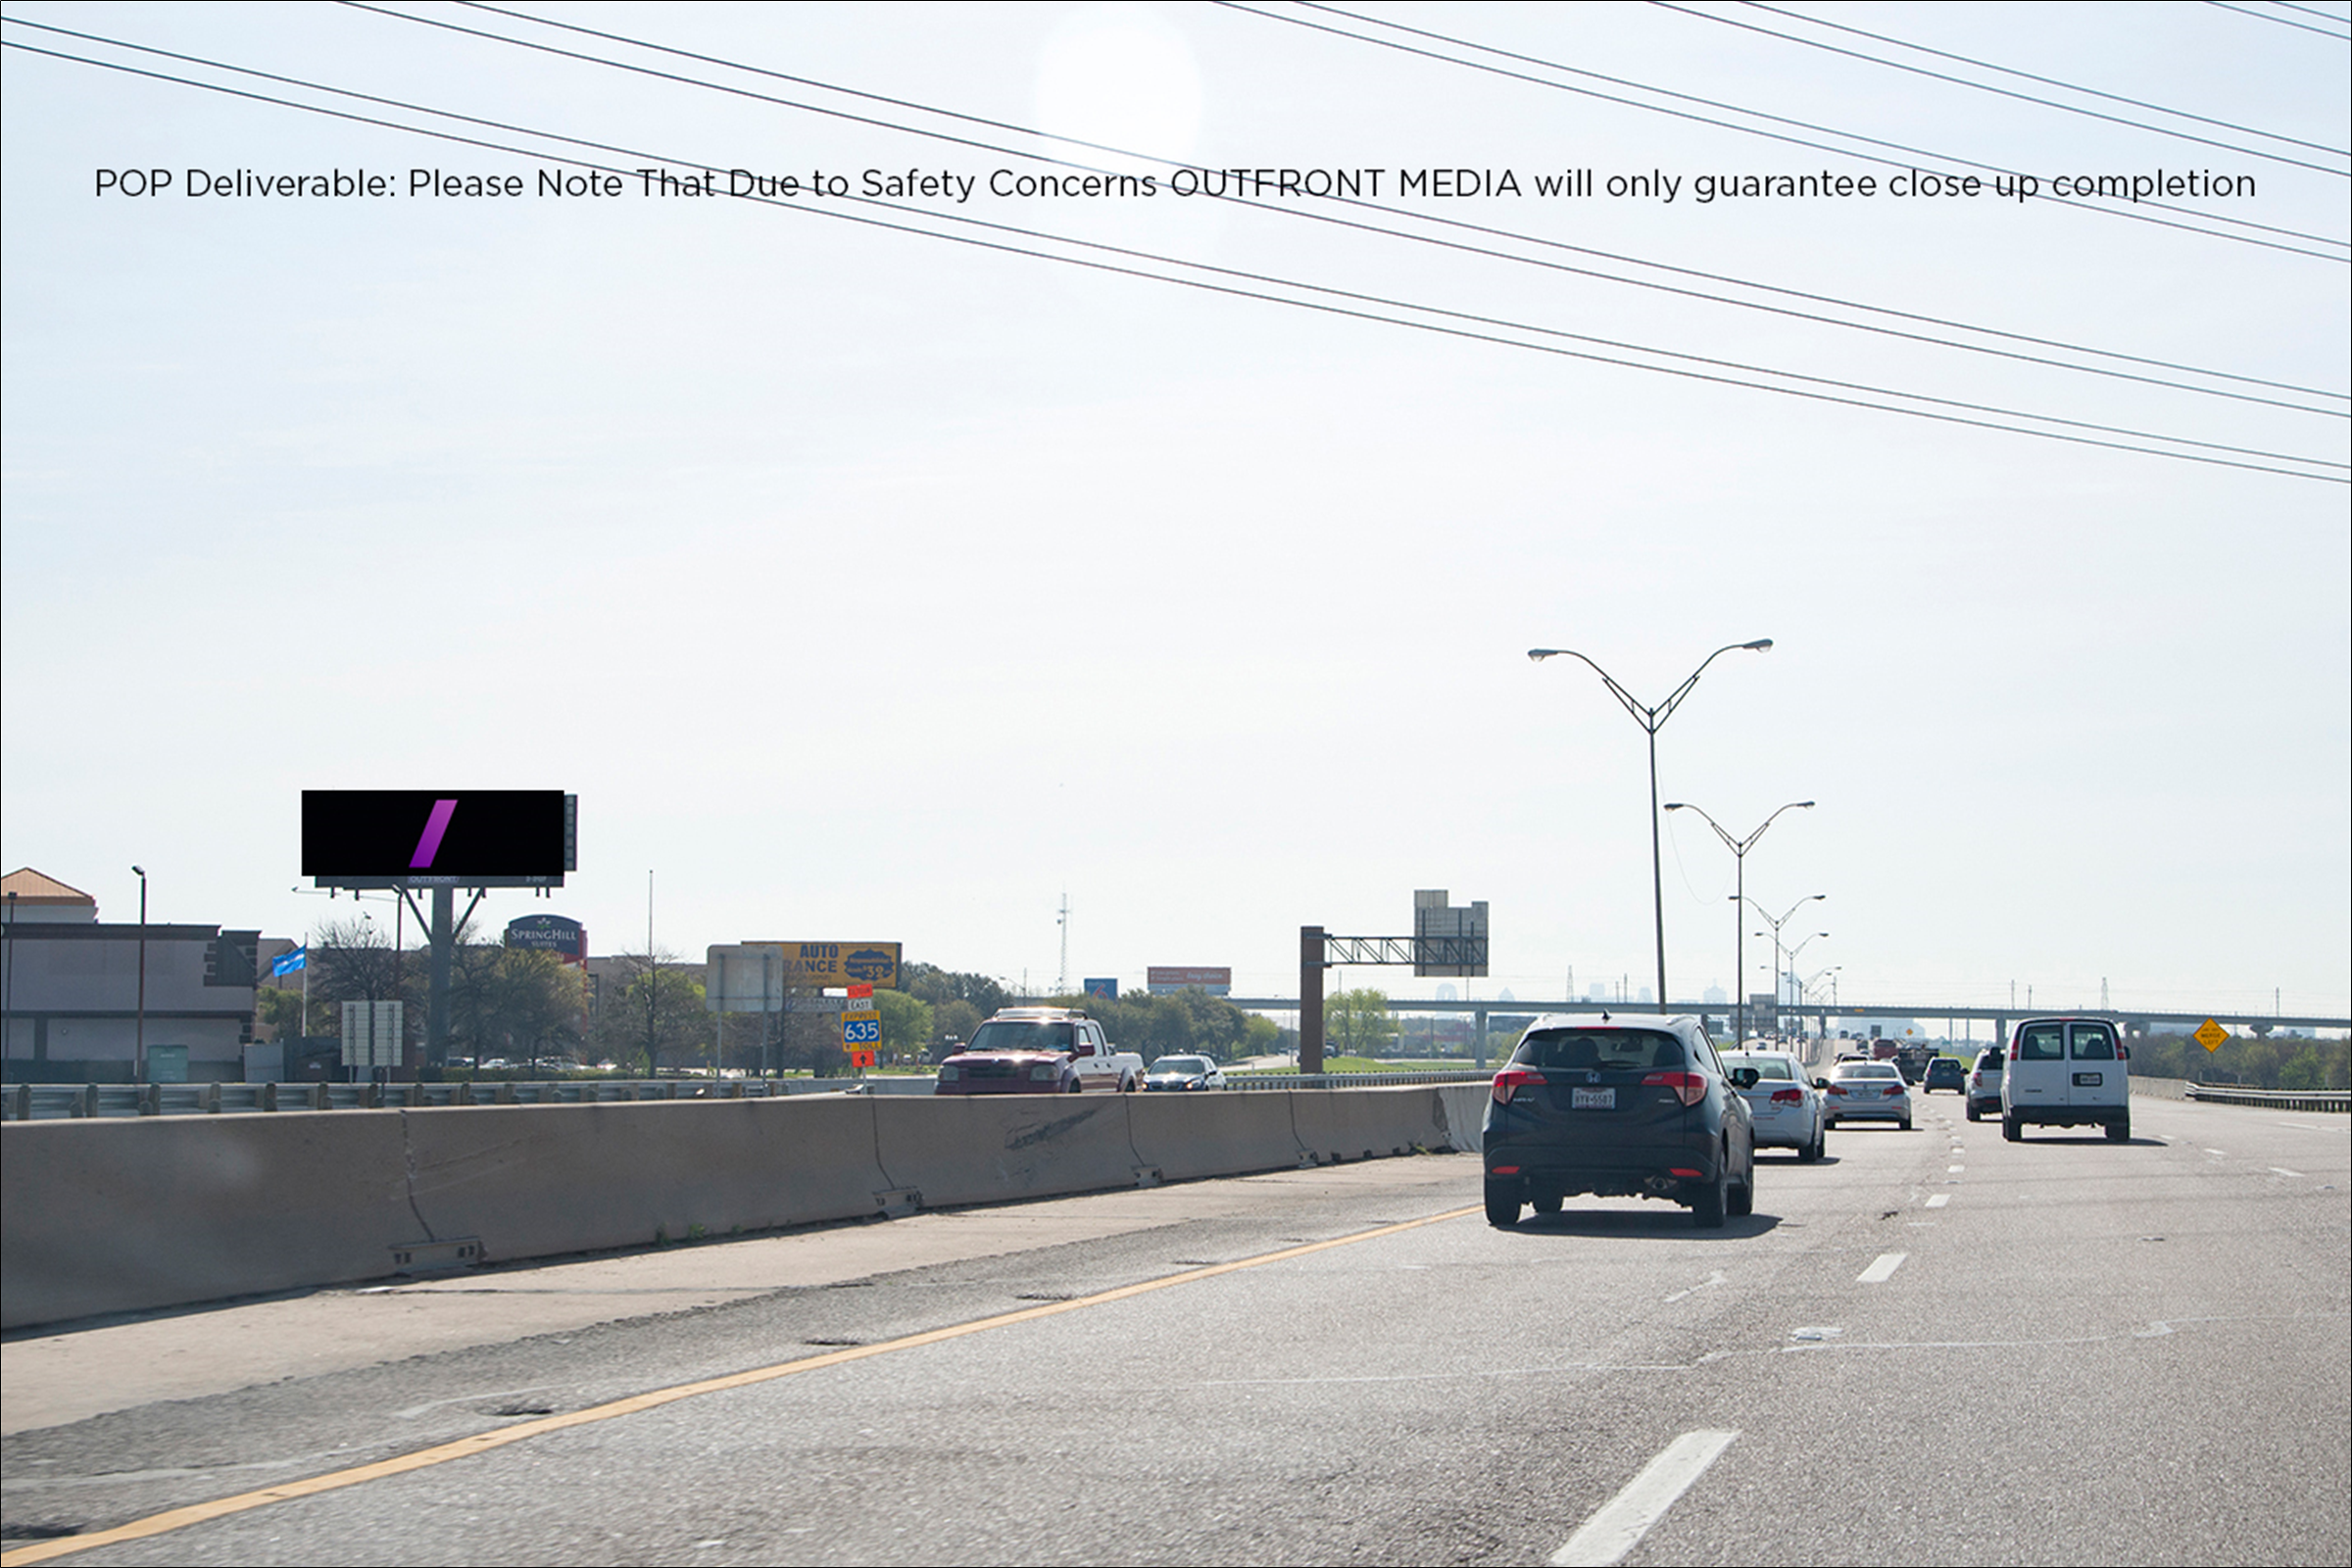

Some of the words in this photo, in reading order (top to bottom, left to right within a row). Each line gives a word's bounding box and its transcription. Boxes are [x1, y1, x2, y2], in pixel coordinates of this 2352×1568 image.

[800, 945, 839, 958] AUTO
[851, 1001, 869, 1010] EAST
[845, 1022, 879, 1041] 635
